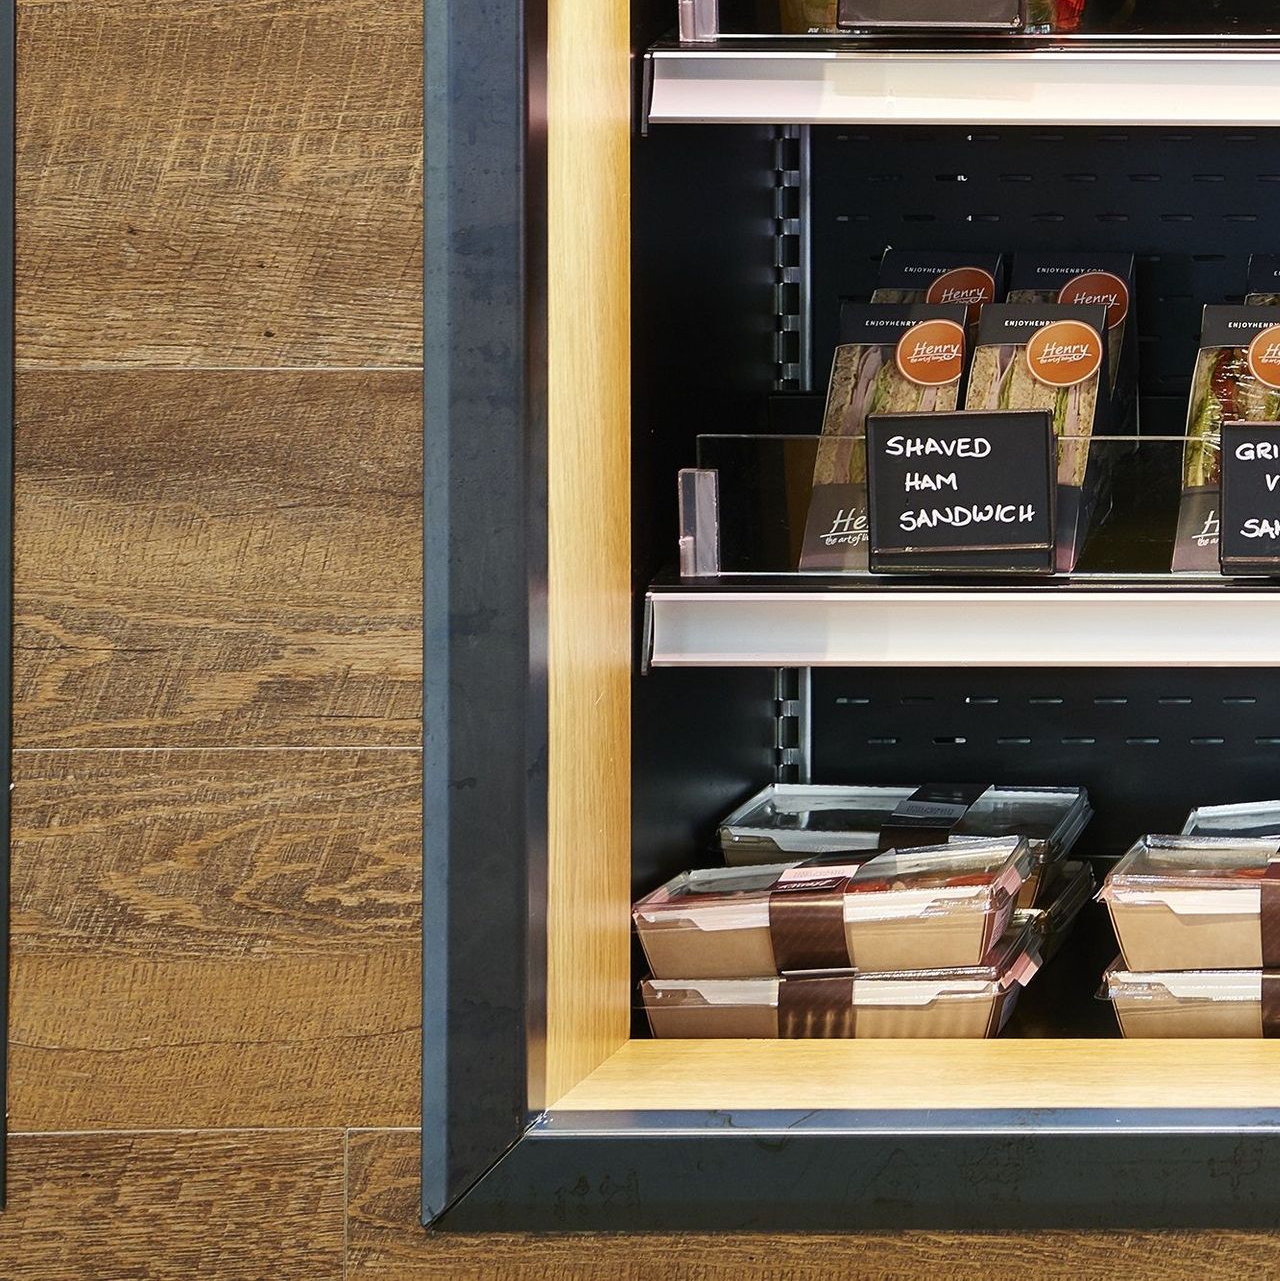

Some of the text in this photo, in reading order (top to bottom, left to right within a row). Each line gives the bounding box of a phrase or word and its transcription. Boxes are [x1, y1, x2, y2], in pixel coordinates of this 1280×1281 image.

[941, 286, 985, 304] Henry
[1073, 292, 1118, 308] Henry
[911, 342, 961, 360] Henry
[1042, 342, 1089, 360] Henry
[885, 435, 992, 458] SHAVED
[904, 472, 958, 493] HAM
[899, 504, 1036, 532] SANDWICH
